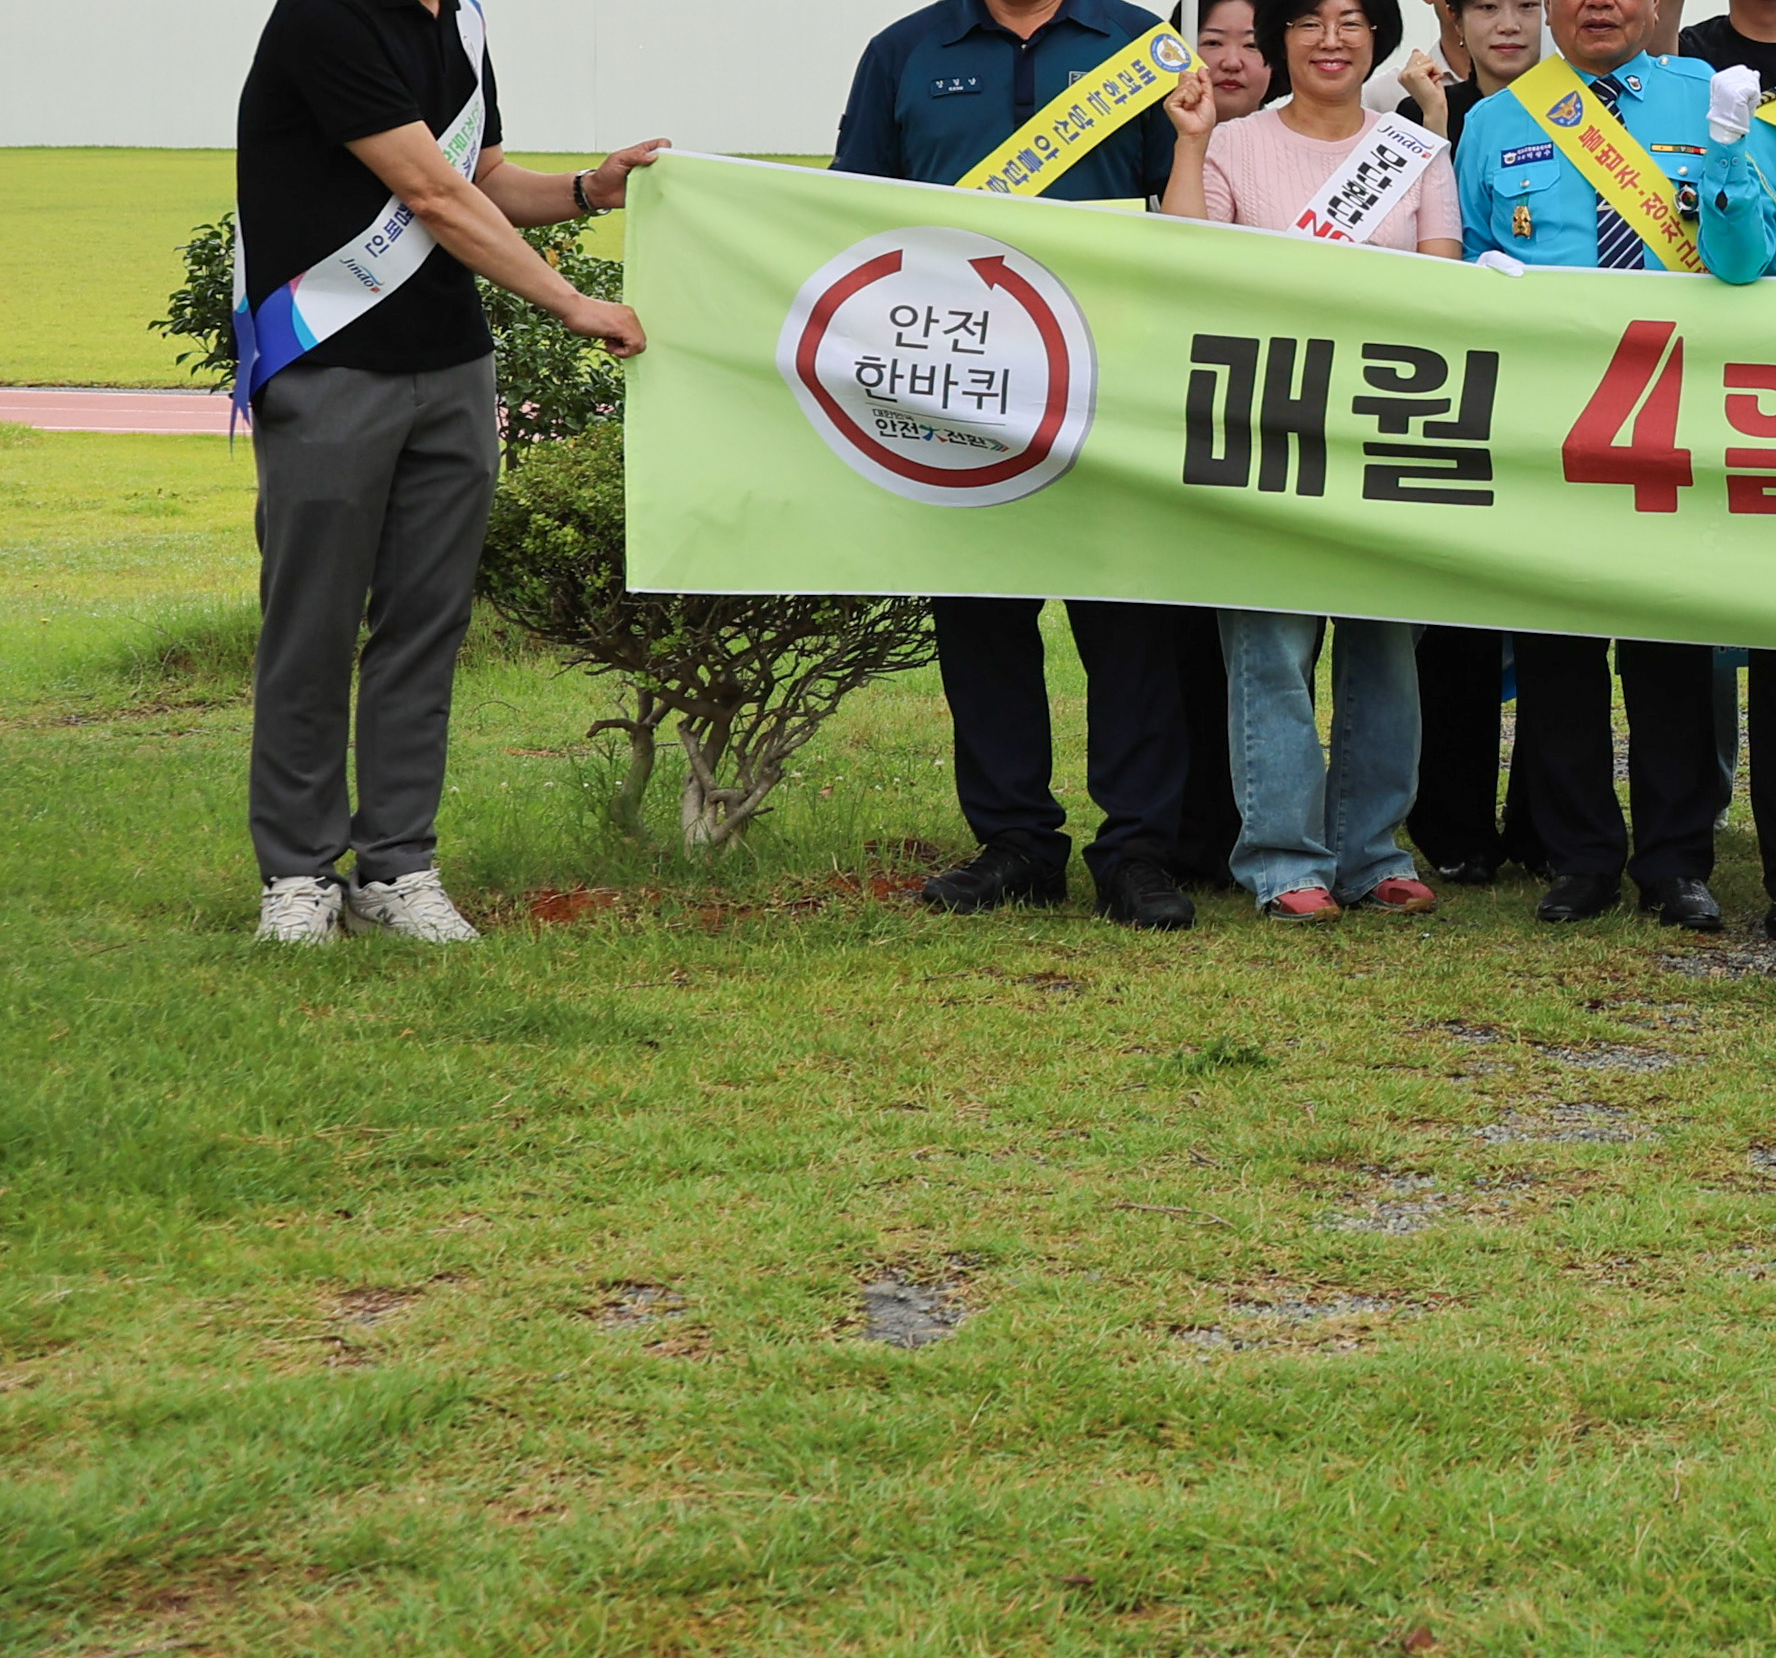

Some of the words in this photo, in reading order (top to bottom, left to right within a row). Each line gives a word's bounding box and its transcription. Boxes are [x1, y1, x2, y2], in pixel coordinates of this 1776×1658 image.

[1086, 59, 1157, 116] 배려하는
[1053, 104, 1094, 145] 당신
[1377, 125, 1423, 154] Jindo
[1326, 144, 1408, 229] 무단횡단
[890, 305, 989, 355] 안전
[854, 356, 1009, 414] 한바퀴
[1182, 332, 1500, 507] 매월
